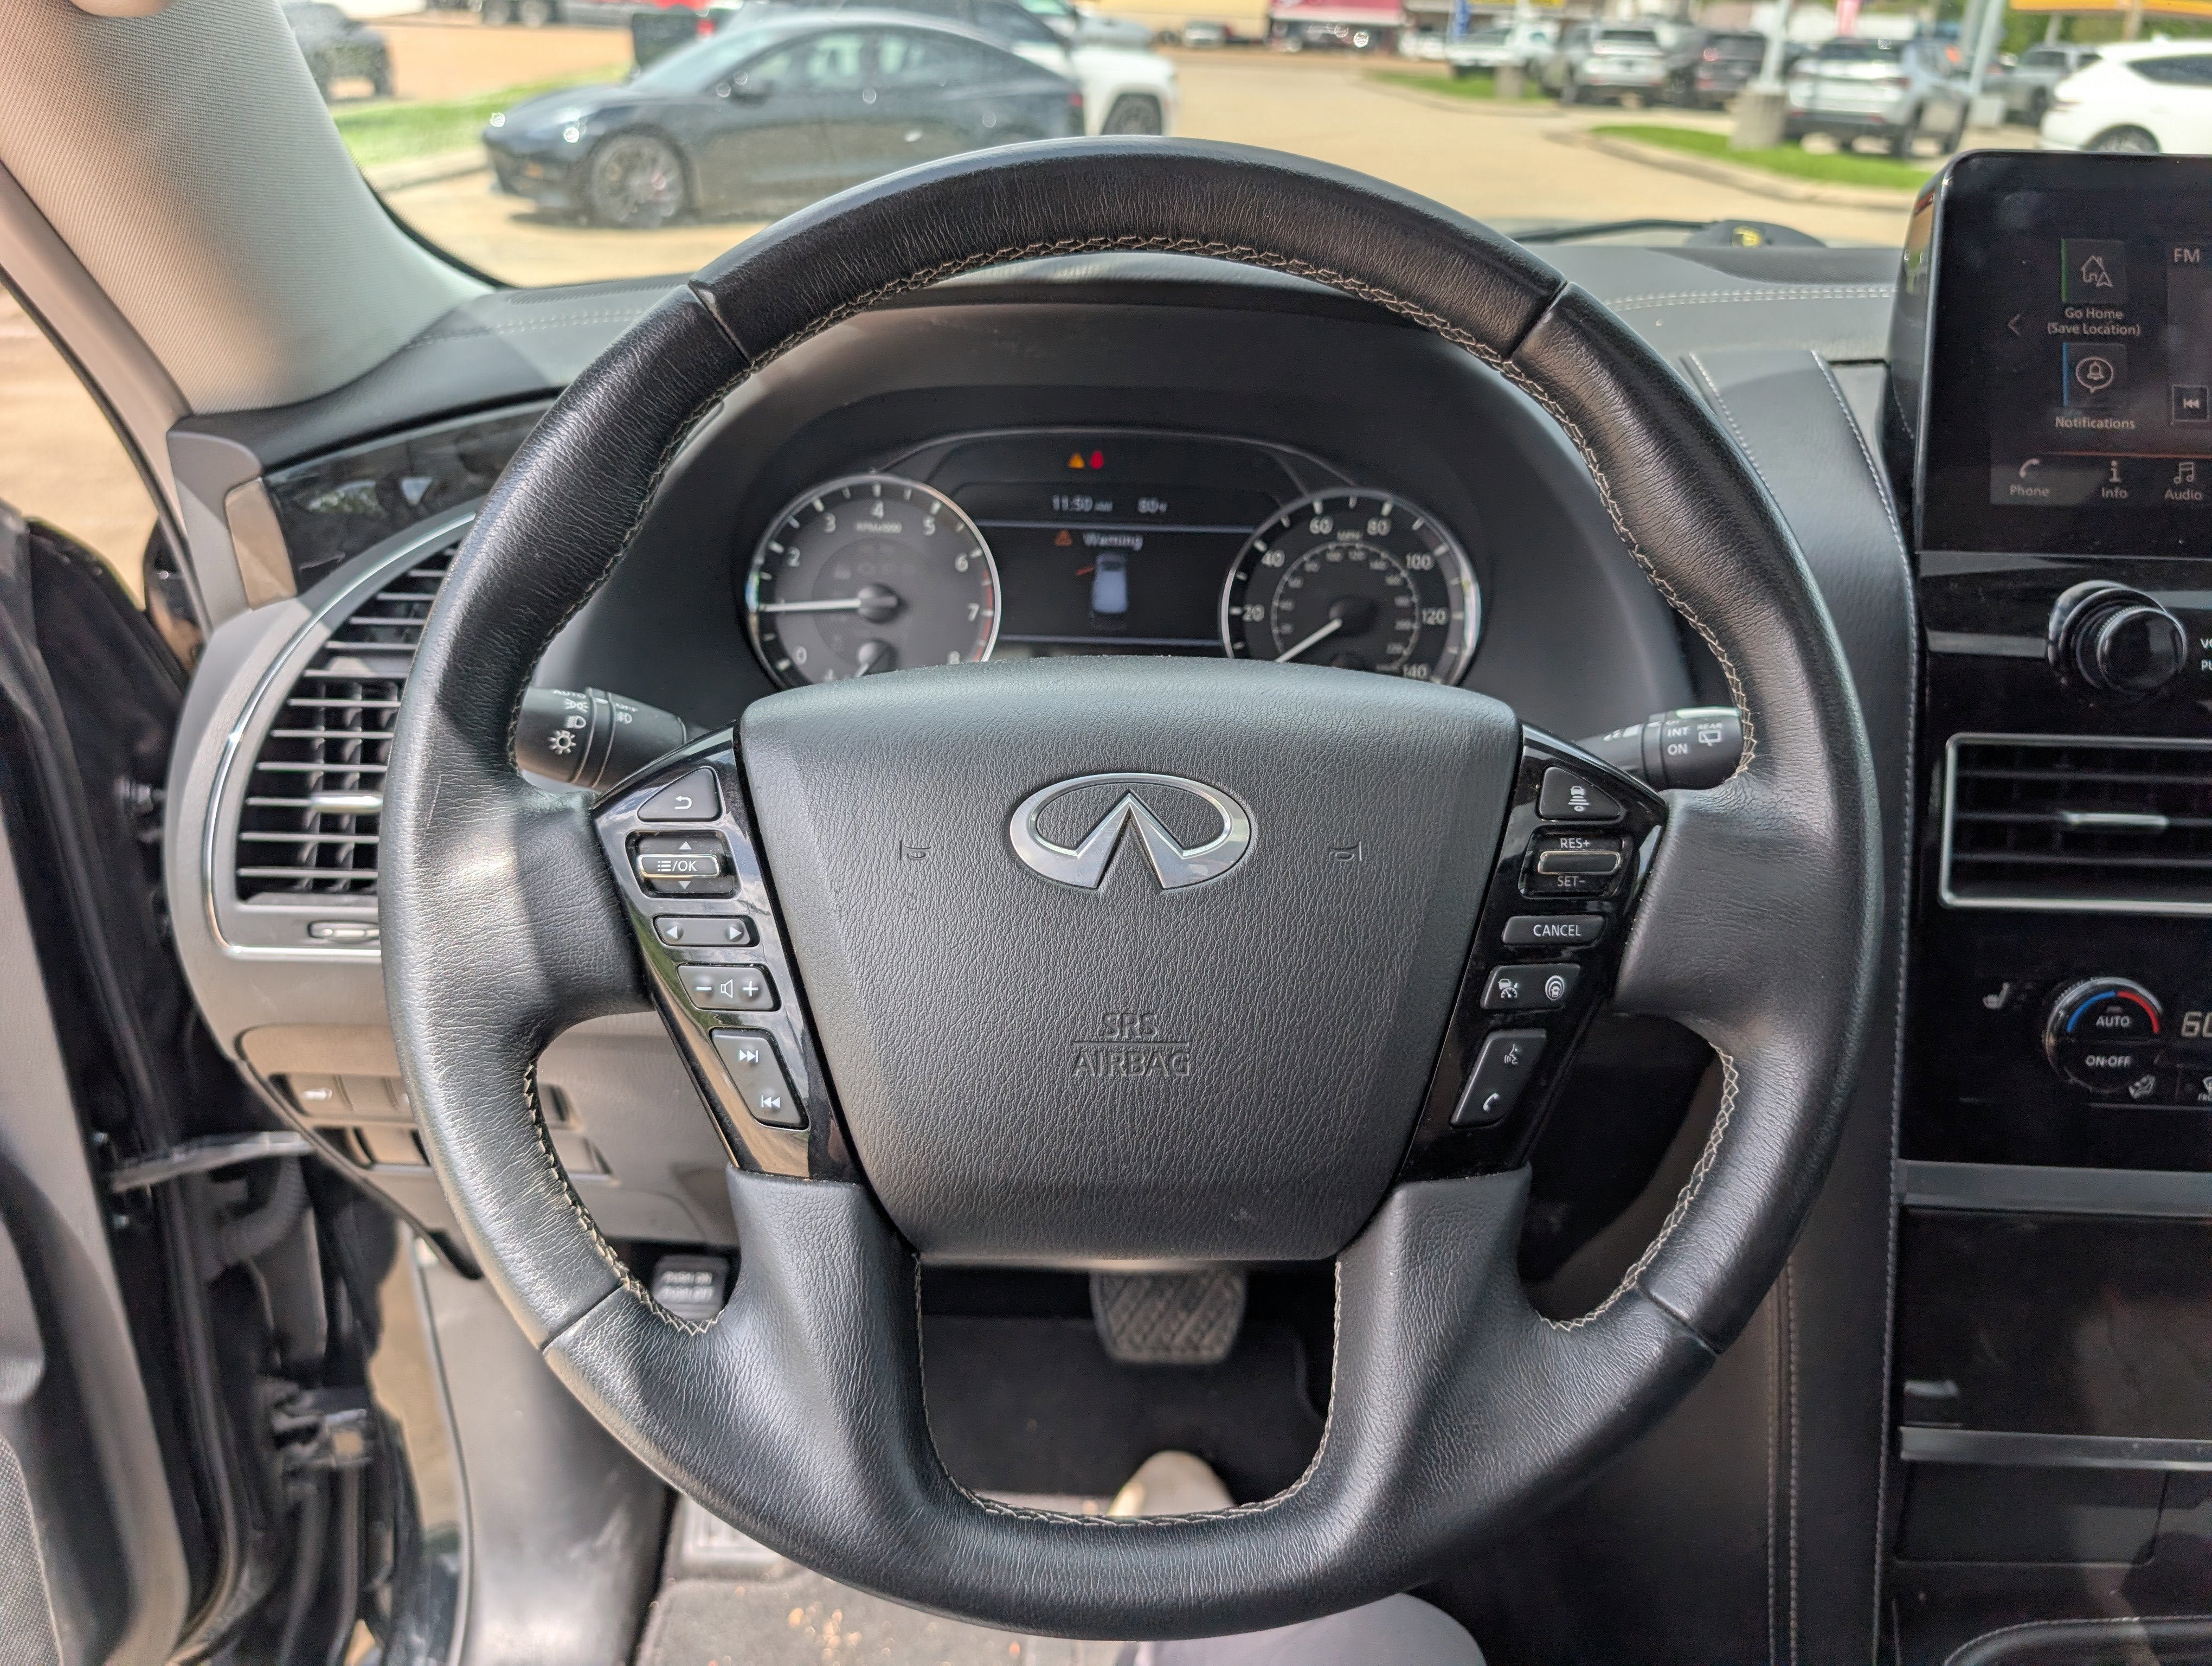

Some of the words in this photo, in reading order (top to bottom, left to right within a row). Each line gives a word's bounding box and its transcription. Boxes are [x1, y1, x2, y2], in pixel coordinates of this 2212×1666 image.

[2173, 248, 2201, 264] FM
[2065, 307, 2083, 319] Go
[2086, 307, 2124, 319] Home
[2048, 322, 2080, 335] (Save
[2083, 323, 2140, 337] Location)
[2055, 416, 2136, 430] Notifications
[2009, 485, 2050, 498] Phone
[2101, 486, 2128, 499] Info
[2164, 489, 2203, 501] Audio
[872, 500, 884, 519] 4
[825, 512, 836, 533] 3
[923, 515, 936, 536] 5
[1309, 516, 1333, 535] 60
[1367, 517, 1391, 536] 80
[1083, 533, 1143, 552] Warning
[788, 547, 801, 567] 2
[955, 552, 969, 573] 6
[1261, 549, 1285, 568] 40
[1406, 553, 1434, 571] 100
[967, 602, 980, 622] 7
[1242, 604, 1265, 622] 20
[1422, 607, 1446, 625] 120
[796, 645, 807, 665] 0
[1402, 663, 1428, 679] 140
[1668, 726, 1690, 738] INT
[1667, 743, 1688, 755] ON
[1560, 838, 1590, 849] RES+
[1557, 876, 1585, 887] SET-
[1533, 924, 1581, 937] CANCEL
[1103, 1013, 1158, 1038] SRS
[2095, 1016, 2131, 1028] AUTO
[1070, 1049, 1190, 1077] AIRBAG
